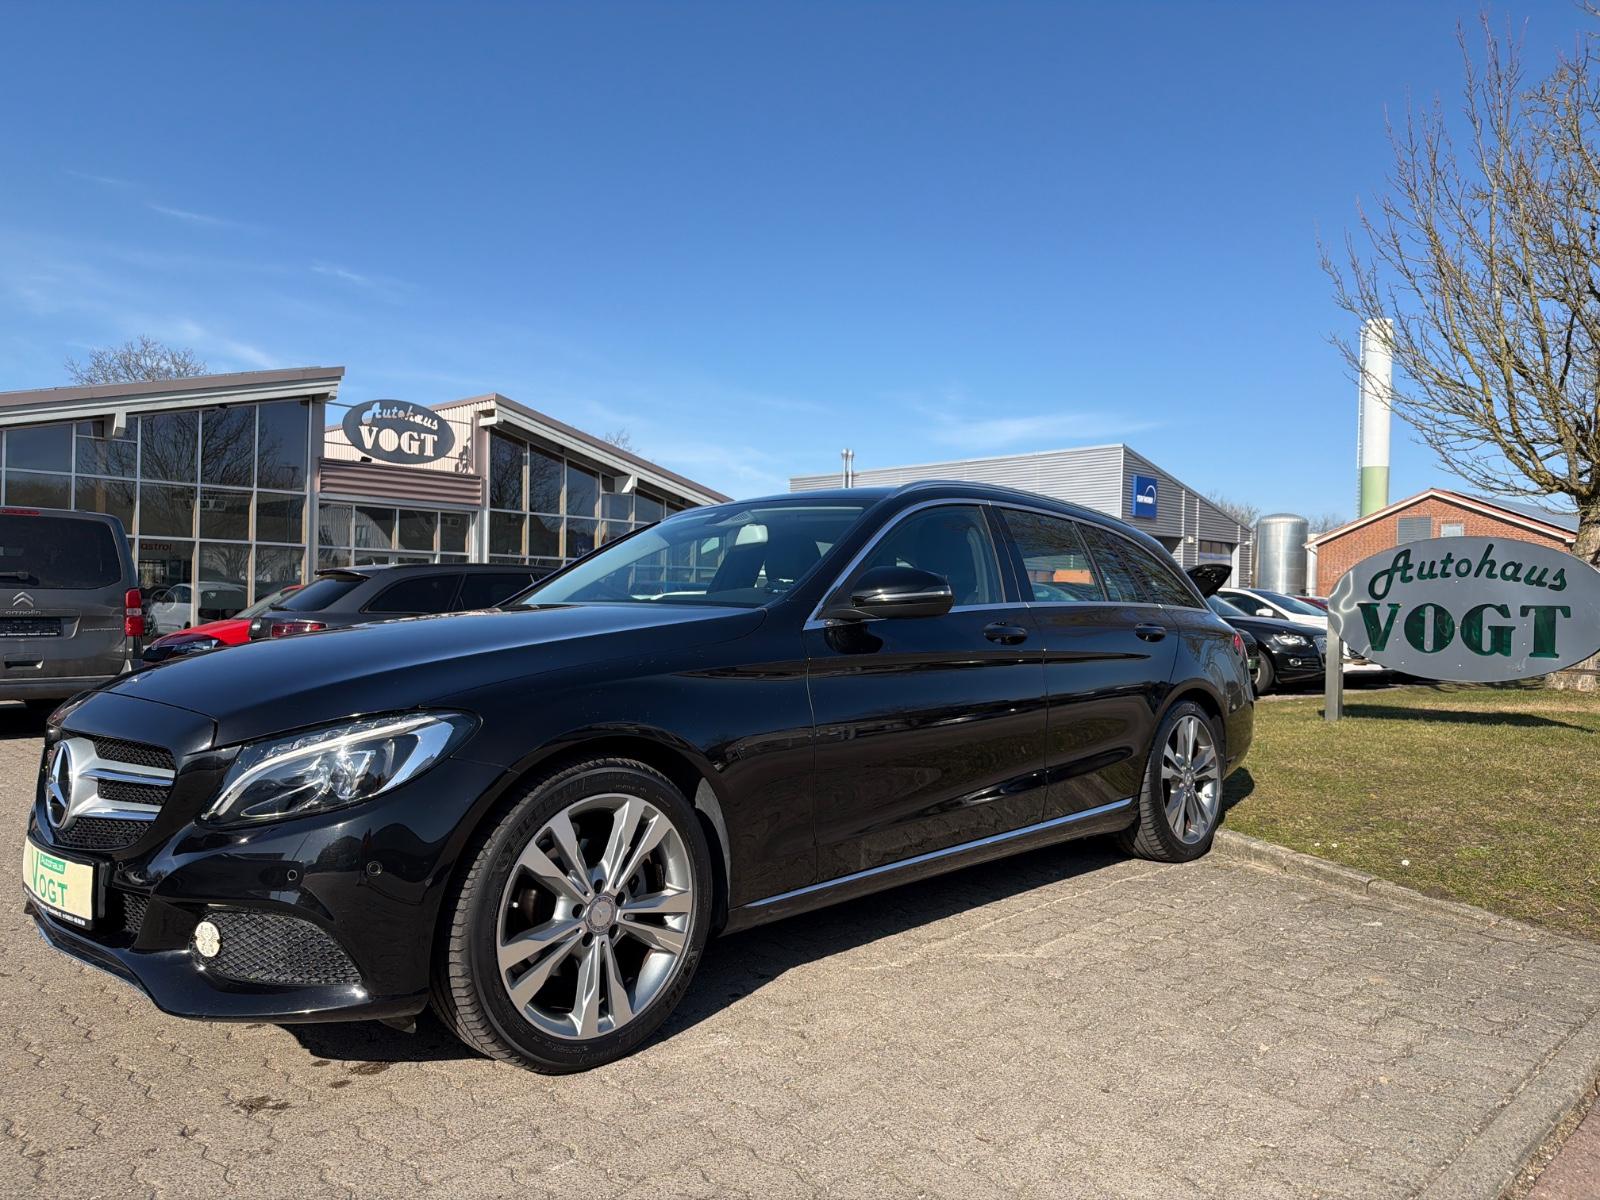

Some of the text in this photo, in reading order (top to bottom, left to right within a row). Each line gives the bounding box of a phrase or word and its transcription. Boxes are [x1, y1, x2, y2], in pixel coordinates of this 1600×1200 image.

[361, 402, 439, 430] Autohaus
[358, 425, 438, 457] VOGT
[140, 543, 172, 551] astrol
[1368, 543, 1568, 600] Autohaus
[1357, 602, 1572, 659] VOGT
